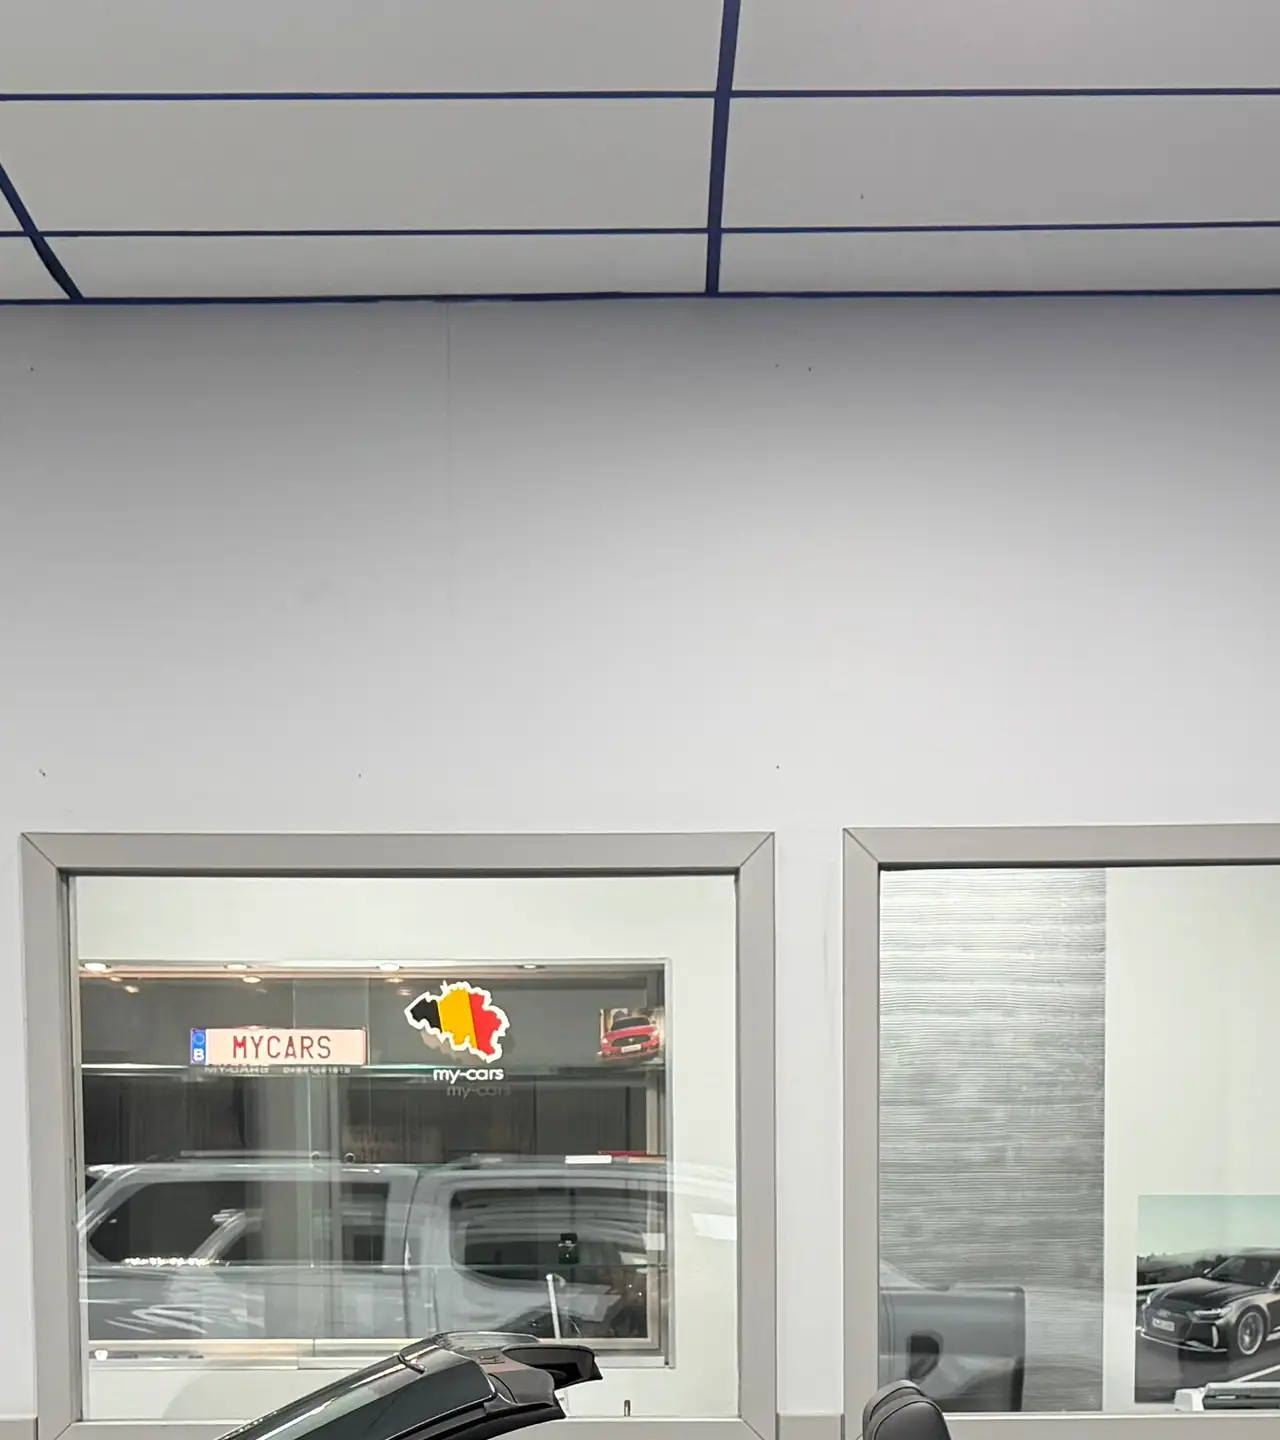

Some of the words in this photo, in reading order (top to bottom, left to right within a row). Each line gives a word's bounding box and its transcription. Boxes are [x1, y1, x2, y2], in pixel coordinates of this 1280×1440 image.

[193, 1048, 205, 1061] B
[232, 1035, 331, 1059] MYCARS
[433, 1068, 504, 1085] my-cars
